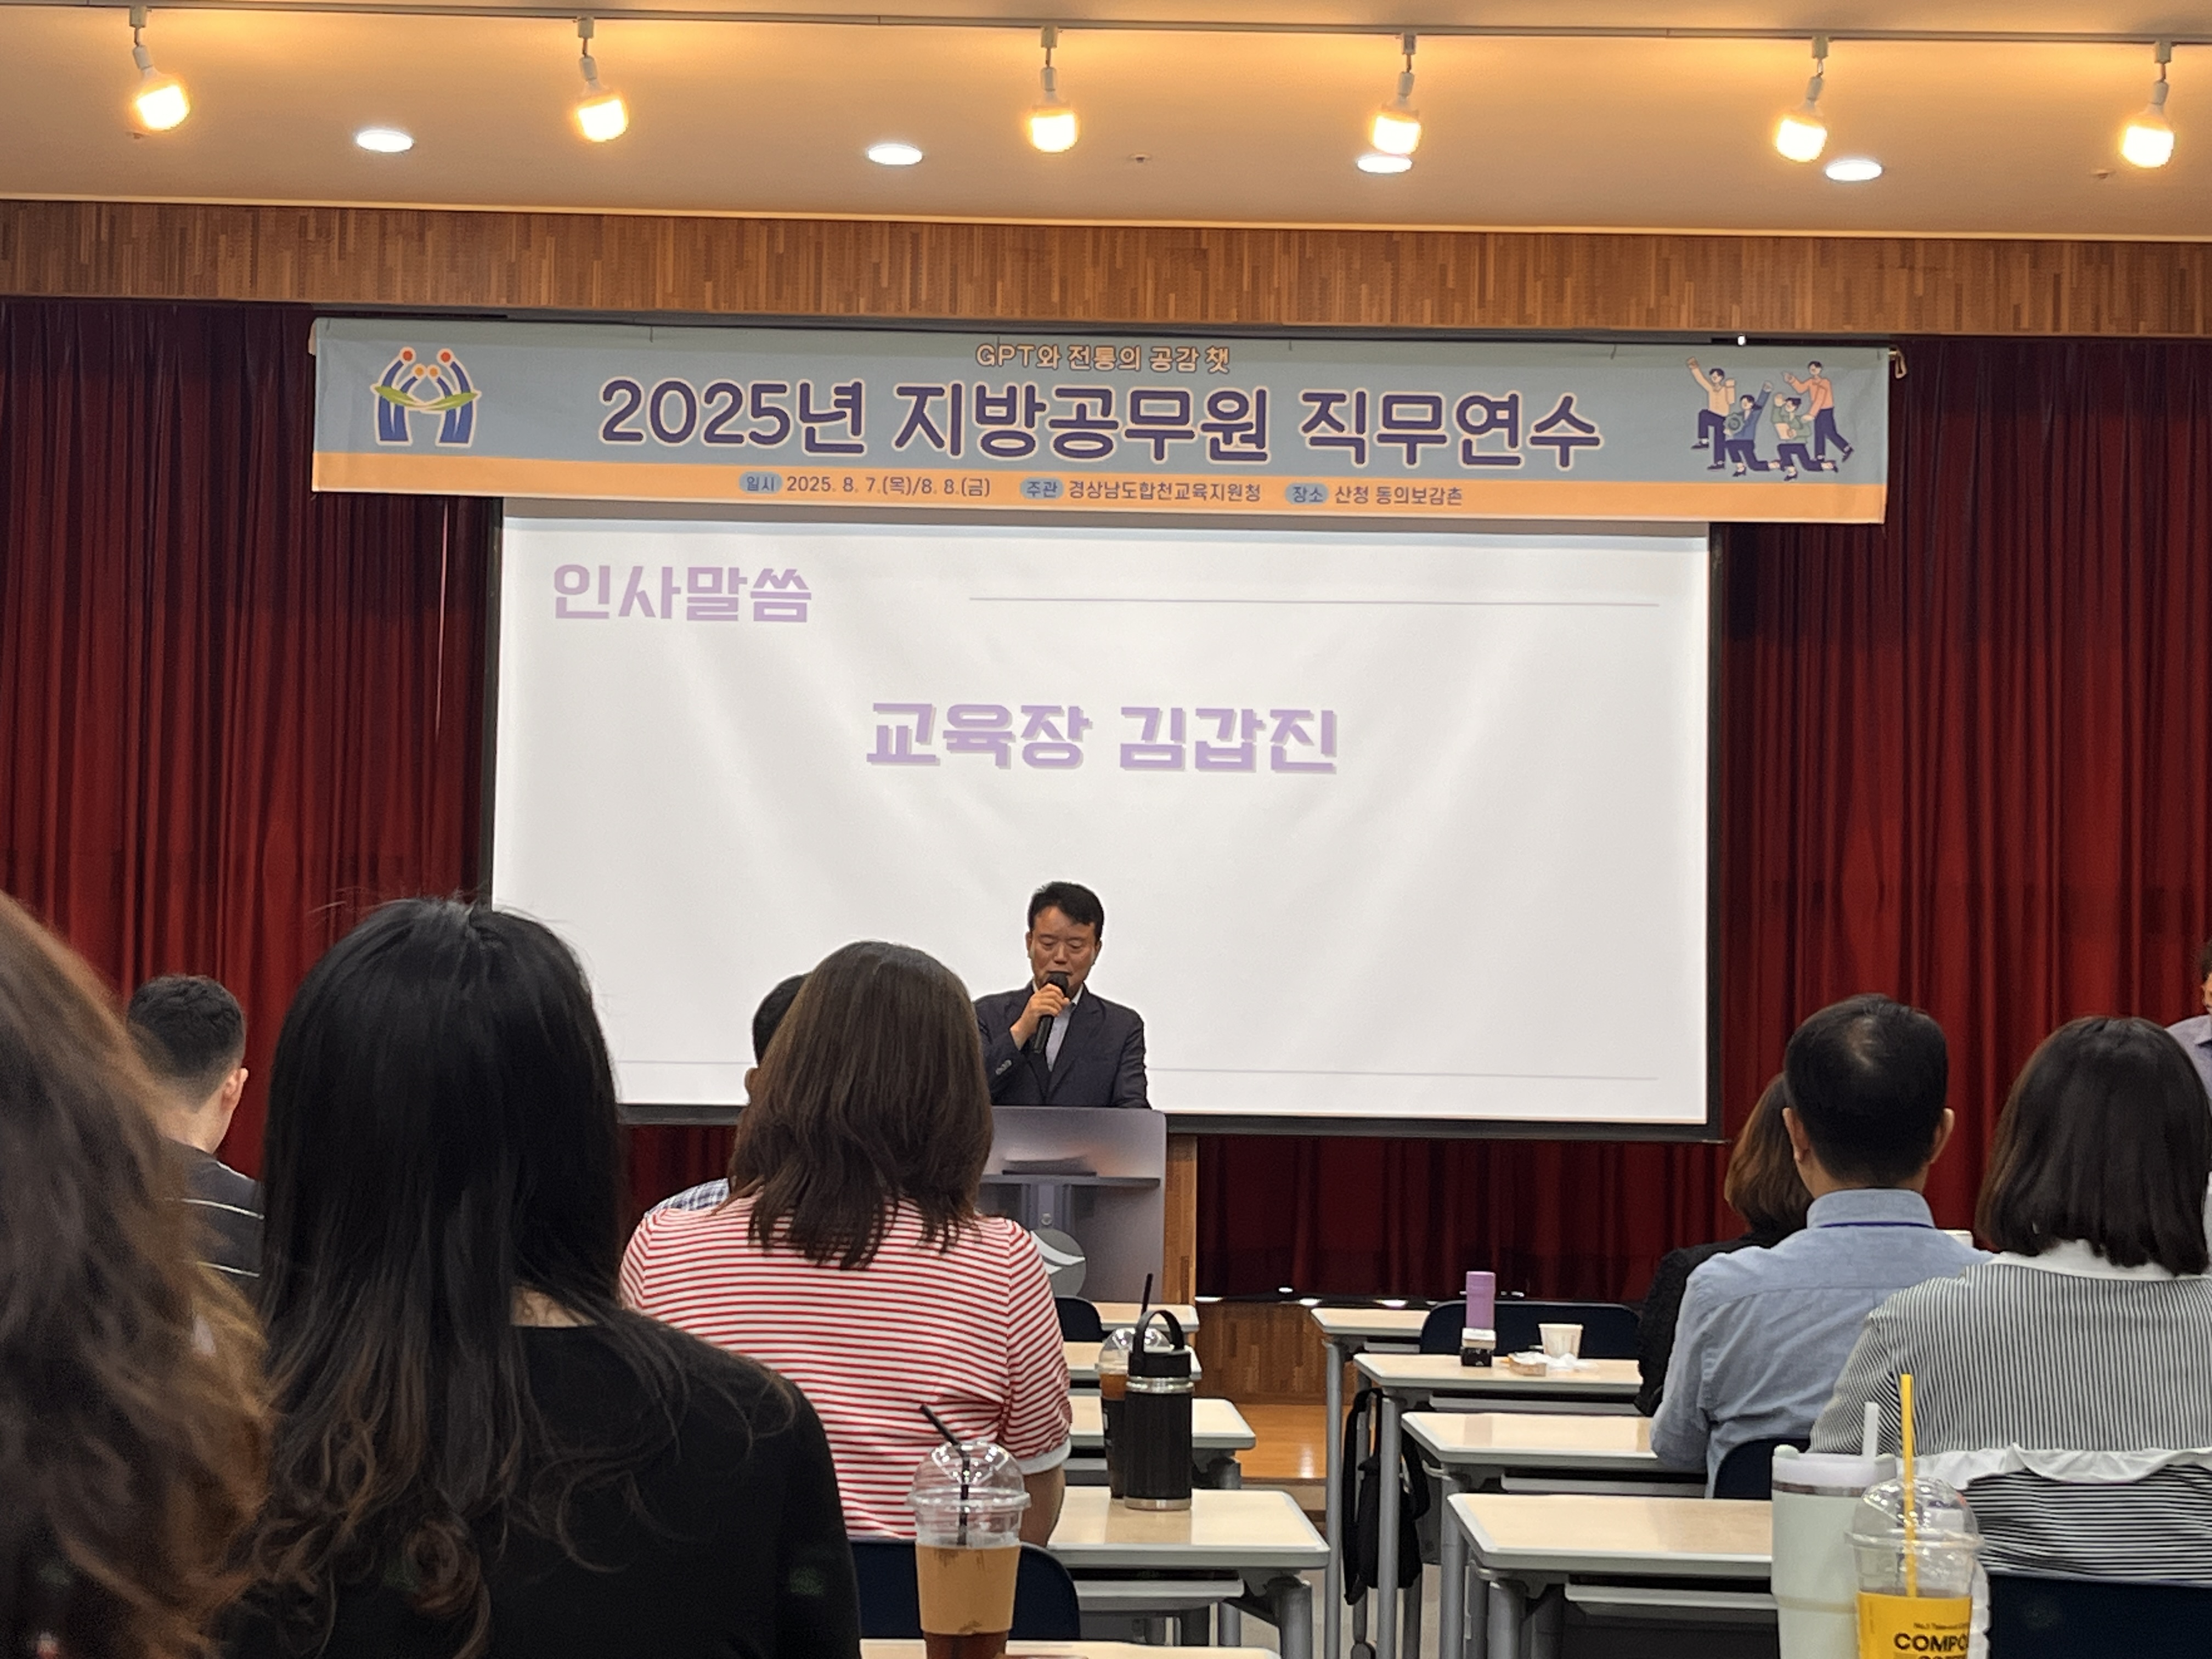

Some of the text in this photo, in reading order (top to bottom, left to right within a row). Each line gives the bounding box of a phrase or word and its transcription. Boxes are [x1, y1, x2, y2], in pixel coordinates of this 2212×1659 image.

[976, 343, 1230, 374] GPT와 전통의 공감 챗
[600, 377, 1604, 470] 2025년 지방공무원 직무연수
[746, 476, 775, 492] 일시
[787, 476, 837, 492] 2025.
[843, 477, 859, 493] 8.
[1026, 481, 1261, 502] 주관 경상남도합천교육지원청
[1293, 486, 1463, 506] 장소 산청 동의보감촌
[554, 563, 812, 623] 인사말씀
[866, 703, 1337, 774] 교육장 김갑진
